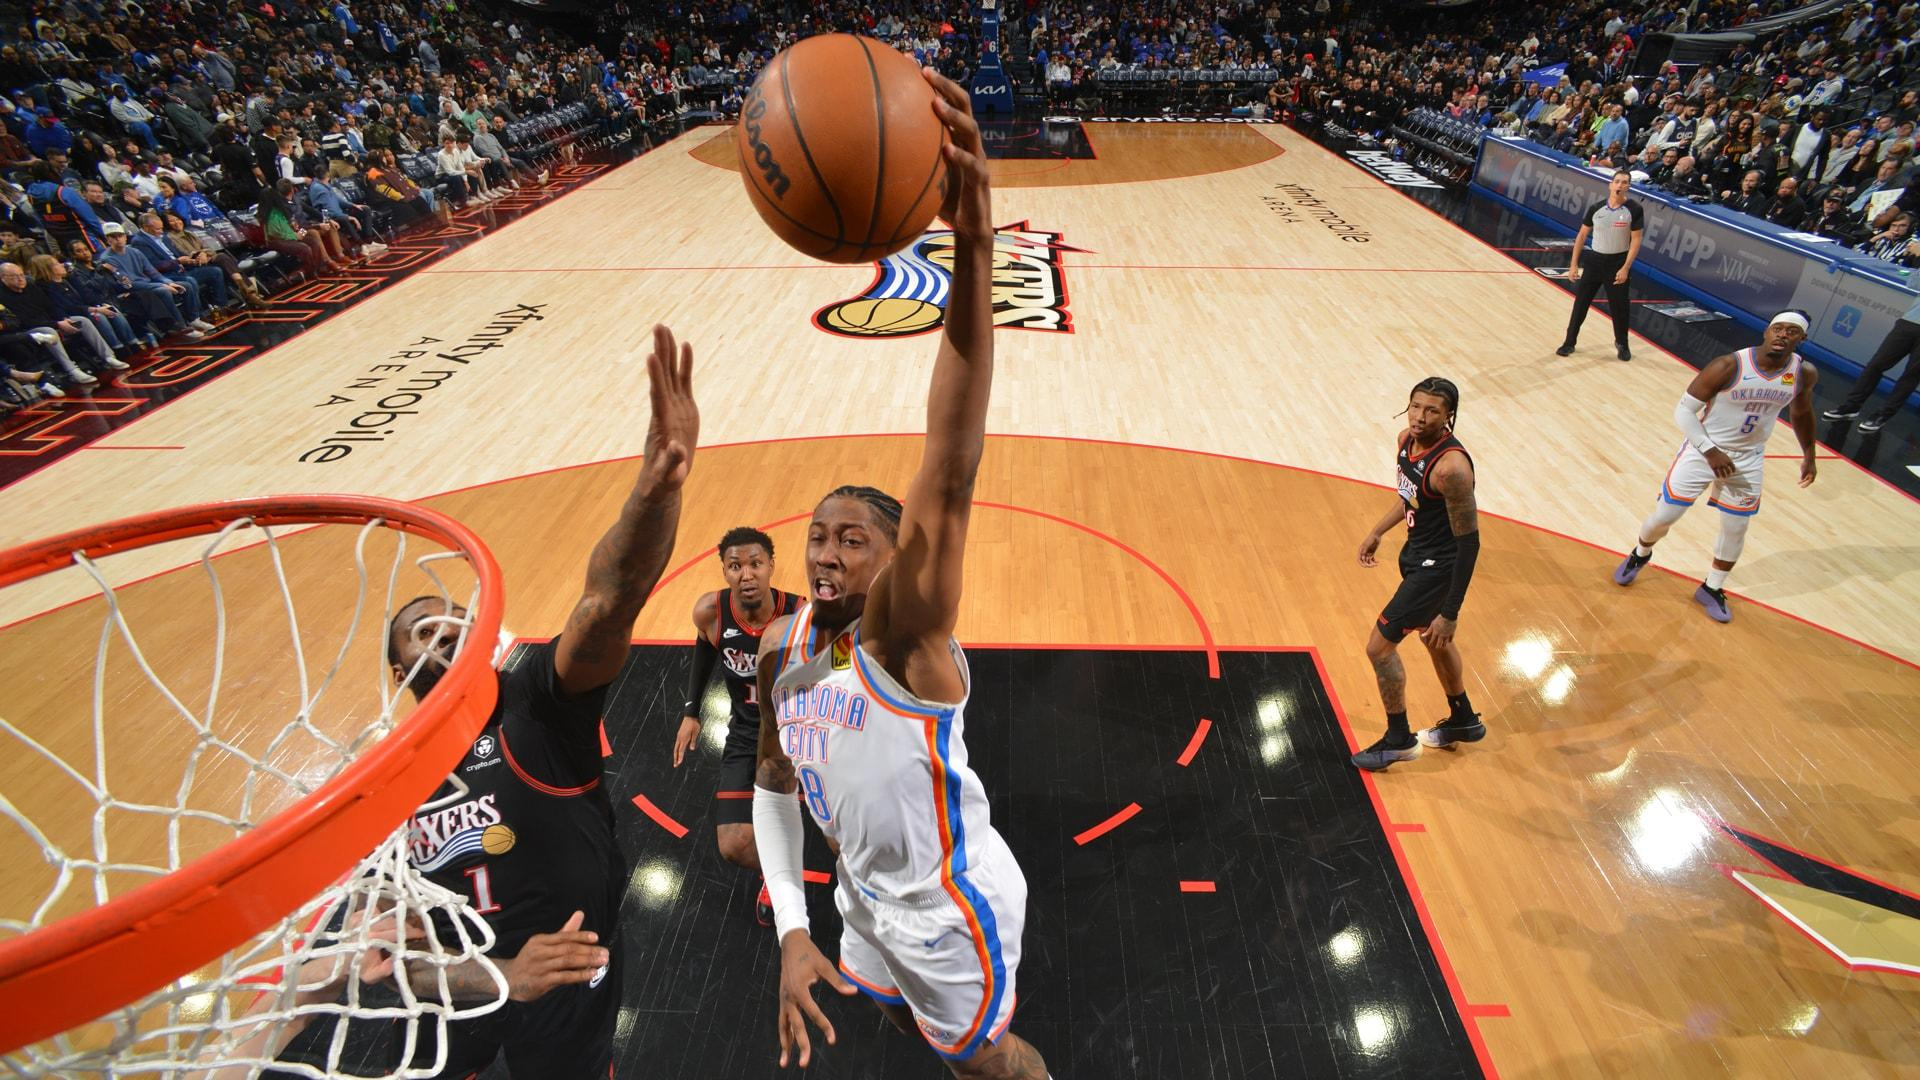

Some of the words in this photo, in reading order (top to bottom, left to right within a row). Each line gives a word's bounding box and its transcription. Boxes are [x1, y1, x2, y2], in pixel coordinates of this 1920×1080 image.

[1258, 195, 1304, 224] ARENA
[1308, 209, 1373, 243] mobile
[1531, 170, 1585, 216] 76ERS
[1658, 224, 1717, 270] APP
[436, 303, 548, 365] xfinity
[313, 336, 445, 408] ARENA
[298, 370, 458, 464] mobile
[1740, 415, 1760, 434] 5
[466, 757, 502, 771] crypto.com
[786, 723, 829, 764] CITY
[799, 765, 835, 827] 8
[463, 864, 501, 915] 1
